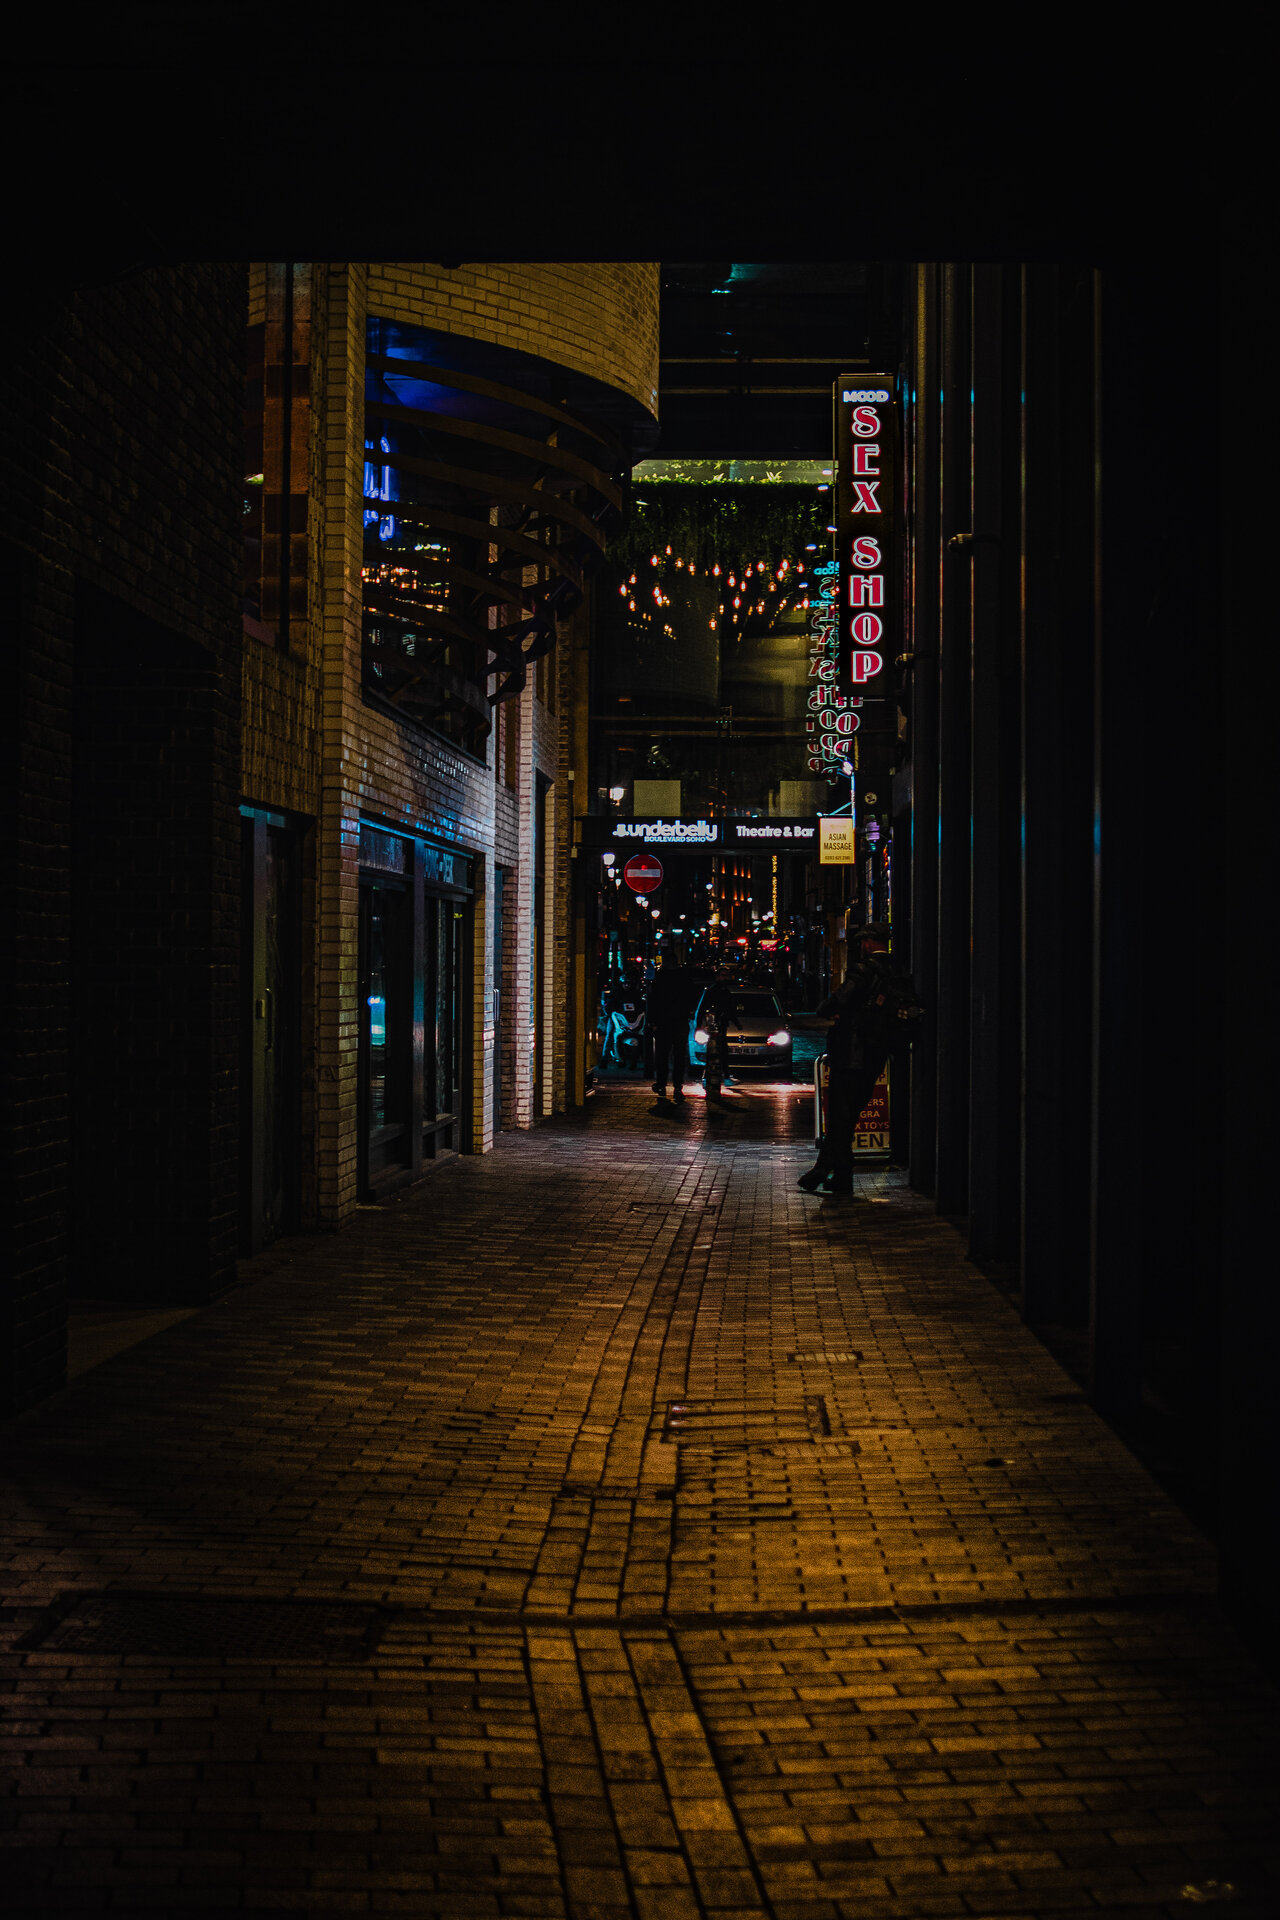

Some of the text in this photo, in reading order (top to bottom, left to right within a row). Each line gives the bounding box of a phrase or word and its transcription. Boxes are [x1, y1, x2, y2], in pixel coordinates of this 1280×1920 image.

[842, 389, 890, 403] MOOD
[848, 404, 885, 685] SEX SHOP
[627, 819, 815, 842] underbelly Theatre & Bar
[828, 833, 847, 841] ASIAN
[823, 842, 852, 851] MASSAGE
[859, 1110, 880, 1119] GRA
[857, 1133, 884, 1148] EN
